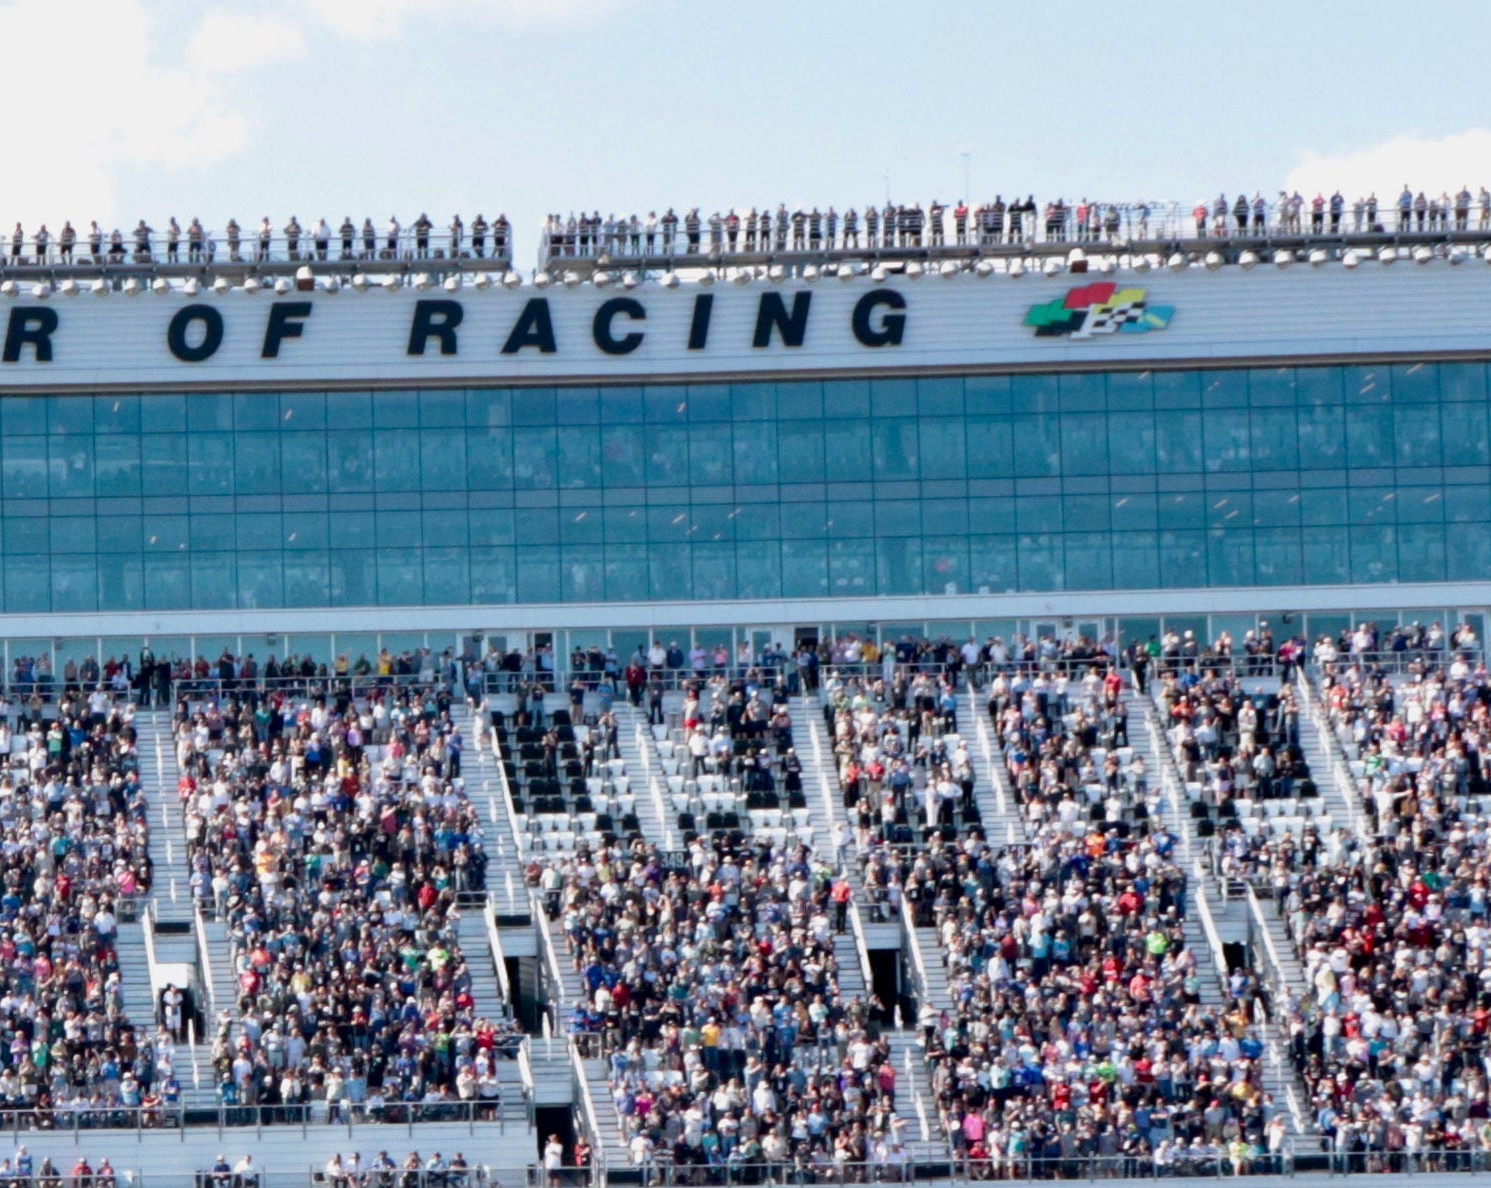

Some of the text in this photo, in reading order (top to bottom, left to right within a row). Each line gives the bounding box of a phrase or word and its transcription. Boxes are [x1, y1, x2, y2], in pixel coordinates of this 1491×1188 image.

[167, 301, 313, 362] OF
[407, 288, 907, 356] RACING
[661, 852, 684, 868] 349
